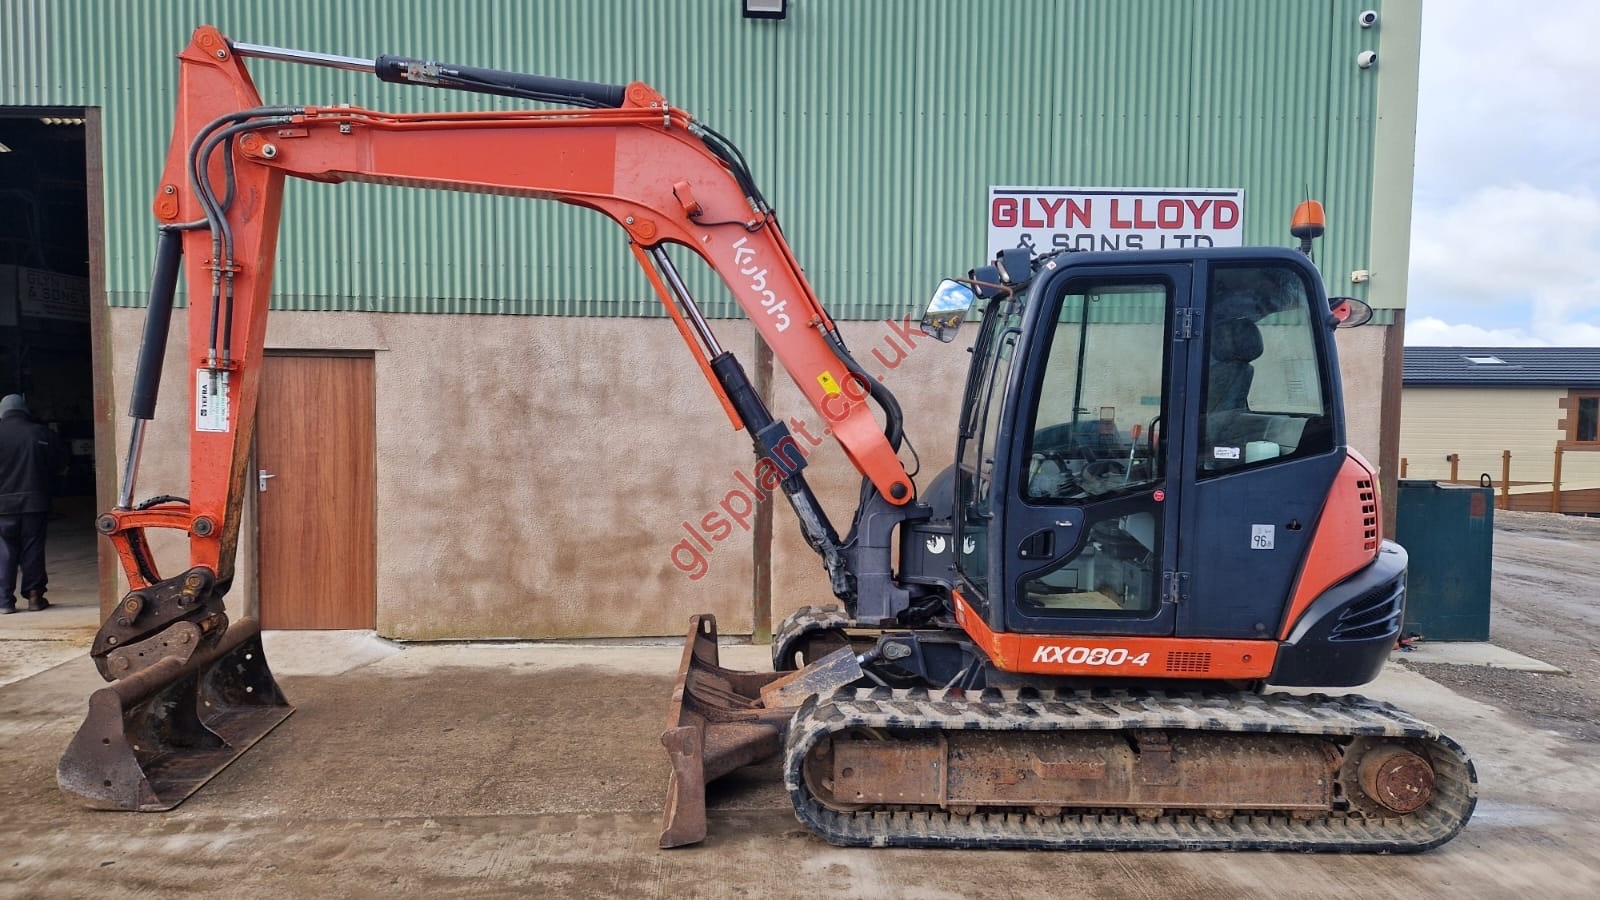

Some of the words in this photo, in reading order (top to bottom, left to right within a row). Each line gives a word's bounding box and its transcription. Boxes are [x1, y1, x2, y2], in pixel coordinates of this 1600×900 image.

[992, 197, 1092, 229] GLYN
[1110, 198, 1239, 230] LLOYD
[1016, 233, 1037, 256] &
[732, 236, 791, 333] Kubota
[1253, 535, 1267, 547] 96
[1032, 645, 1151, 667] KX080-4
